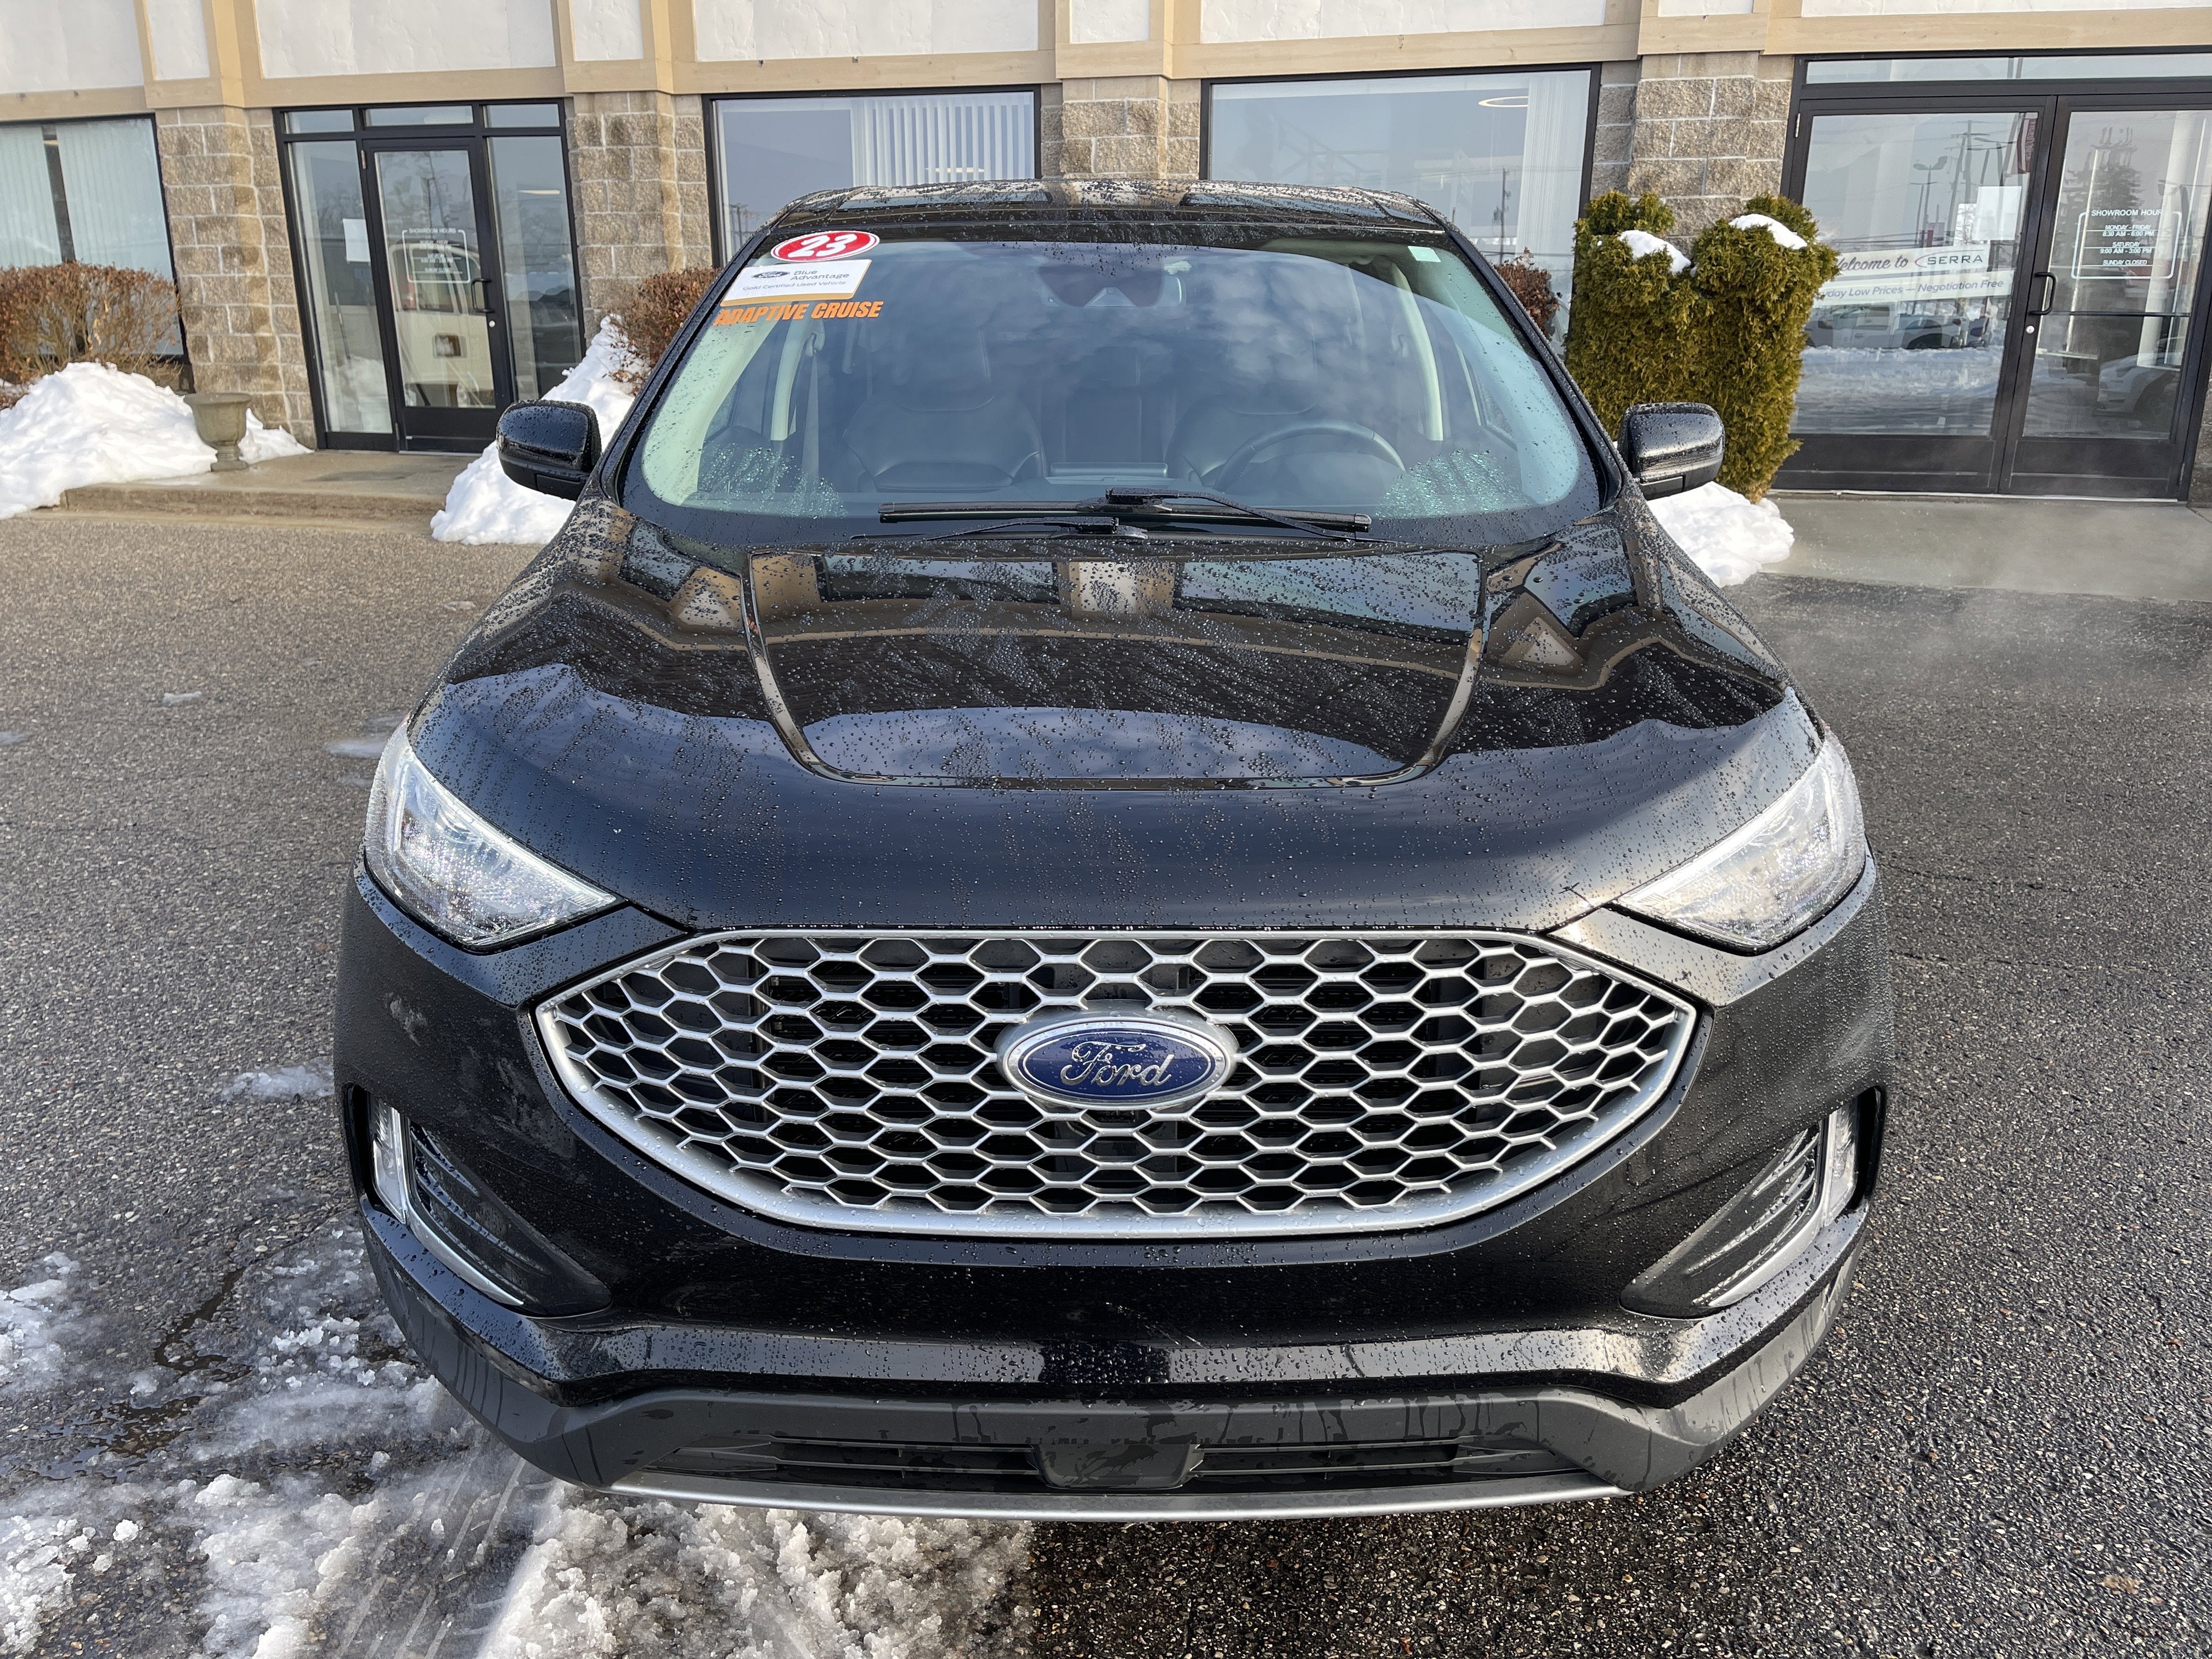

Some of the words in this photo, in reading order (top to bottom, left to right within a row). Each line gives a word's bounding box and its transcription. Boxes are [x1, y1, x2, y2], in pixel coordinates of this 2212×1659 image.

[788, 235, 857, 258] 23
[1895, 255, 1909, 268] to
[1927, 255, 1983, 265] SERRA
[1872, 286, 1903, 295] Prices
[1918, 281, 1978, 293] Negotiation
[1980, 280, 2004, 288] Free
[713, 303, 810, 326] ADAPTIVE
[811, 301, 884, 319] CRUISE
[1060, 1041, 1175, 1086] Ford
